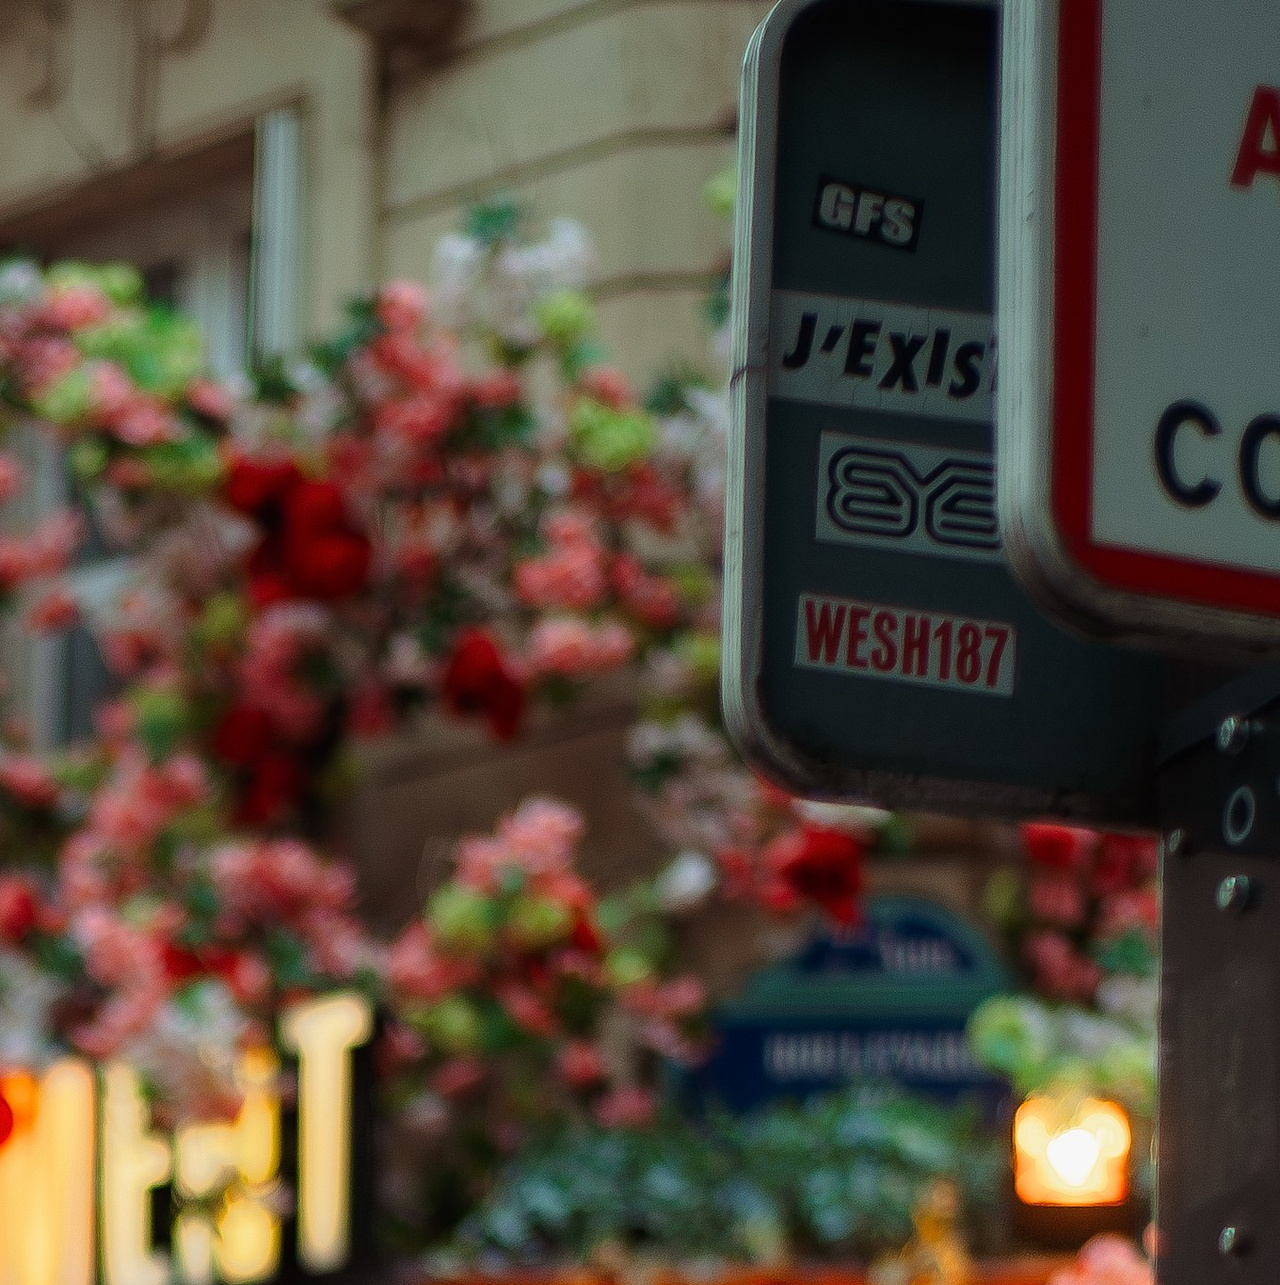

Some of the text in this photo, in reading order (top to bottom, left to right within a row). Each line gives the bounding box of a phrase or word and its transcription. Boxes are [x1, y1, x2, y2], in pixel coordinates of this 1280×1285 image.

[820, 182, 916, 246] GFS
[782, 311, 997, 399] J'EXIS
[804, 600, 1009, 688] WESH187
